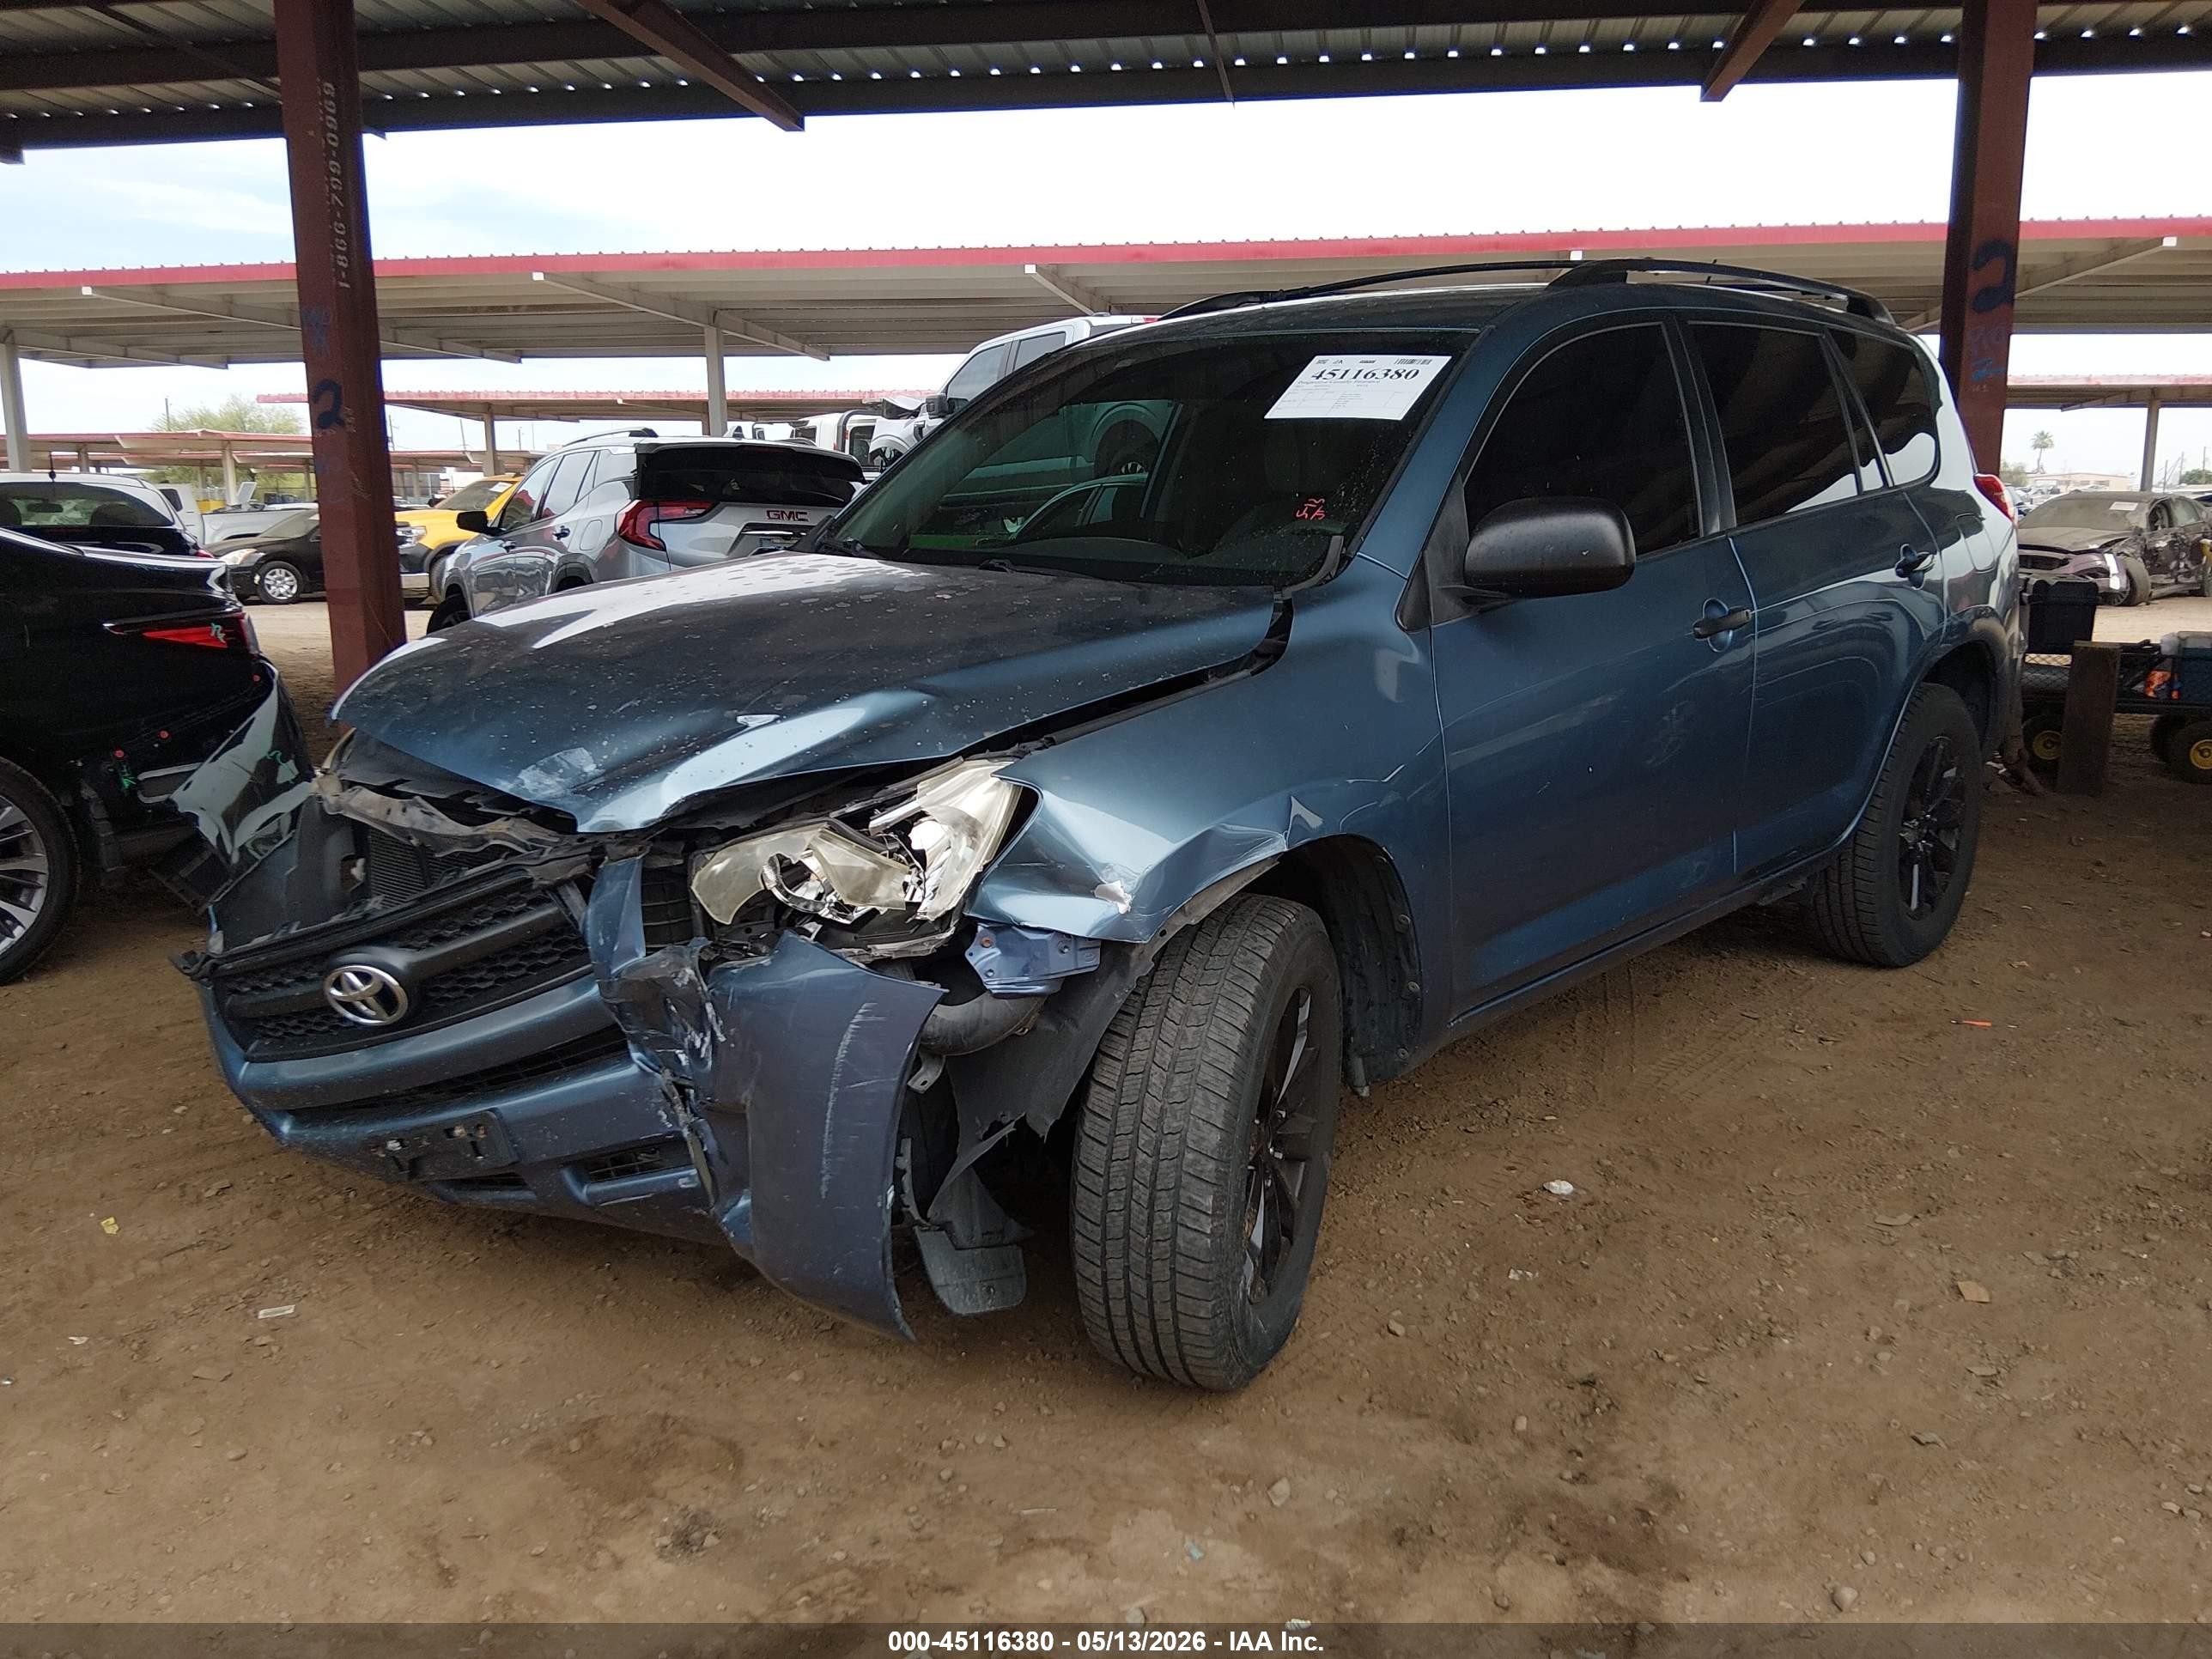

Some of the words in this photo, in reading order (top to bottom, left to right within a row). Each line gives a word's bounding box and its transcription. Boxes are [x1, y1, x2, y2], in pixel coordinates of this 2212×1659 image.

[322, 82, 351, 289] 1-866-799-0969
[1972, 240, 2014, 313] 2
[1311, 368, 1420, 380] 45116380
[313, 379, 345, 429] 2
[766, 509, 809, 522] GMC
